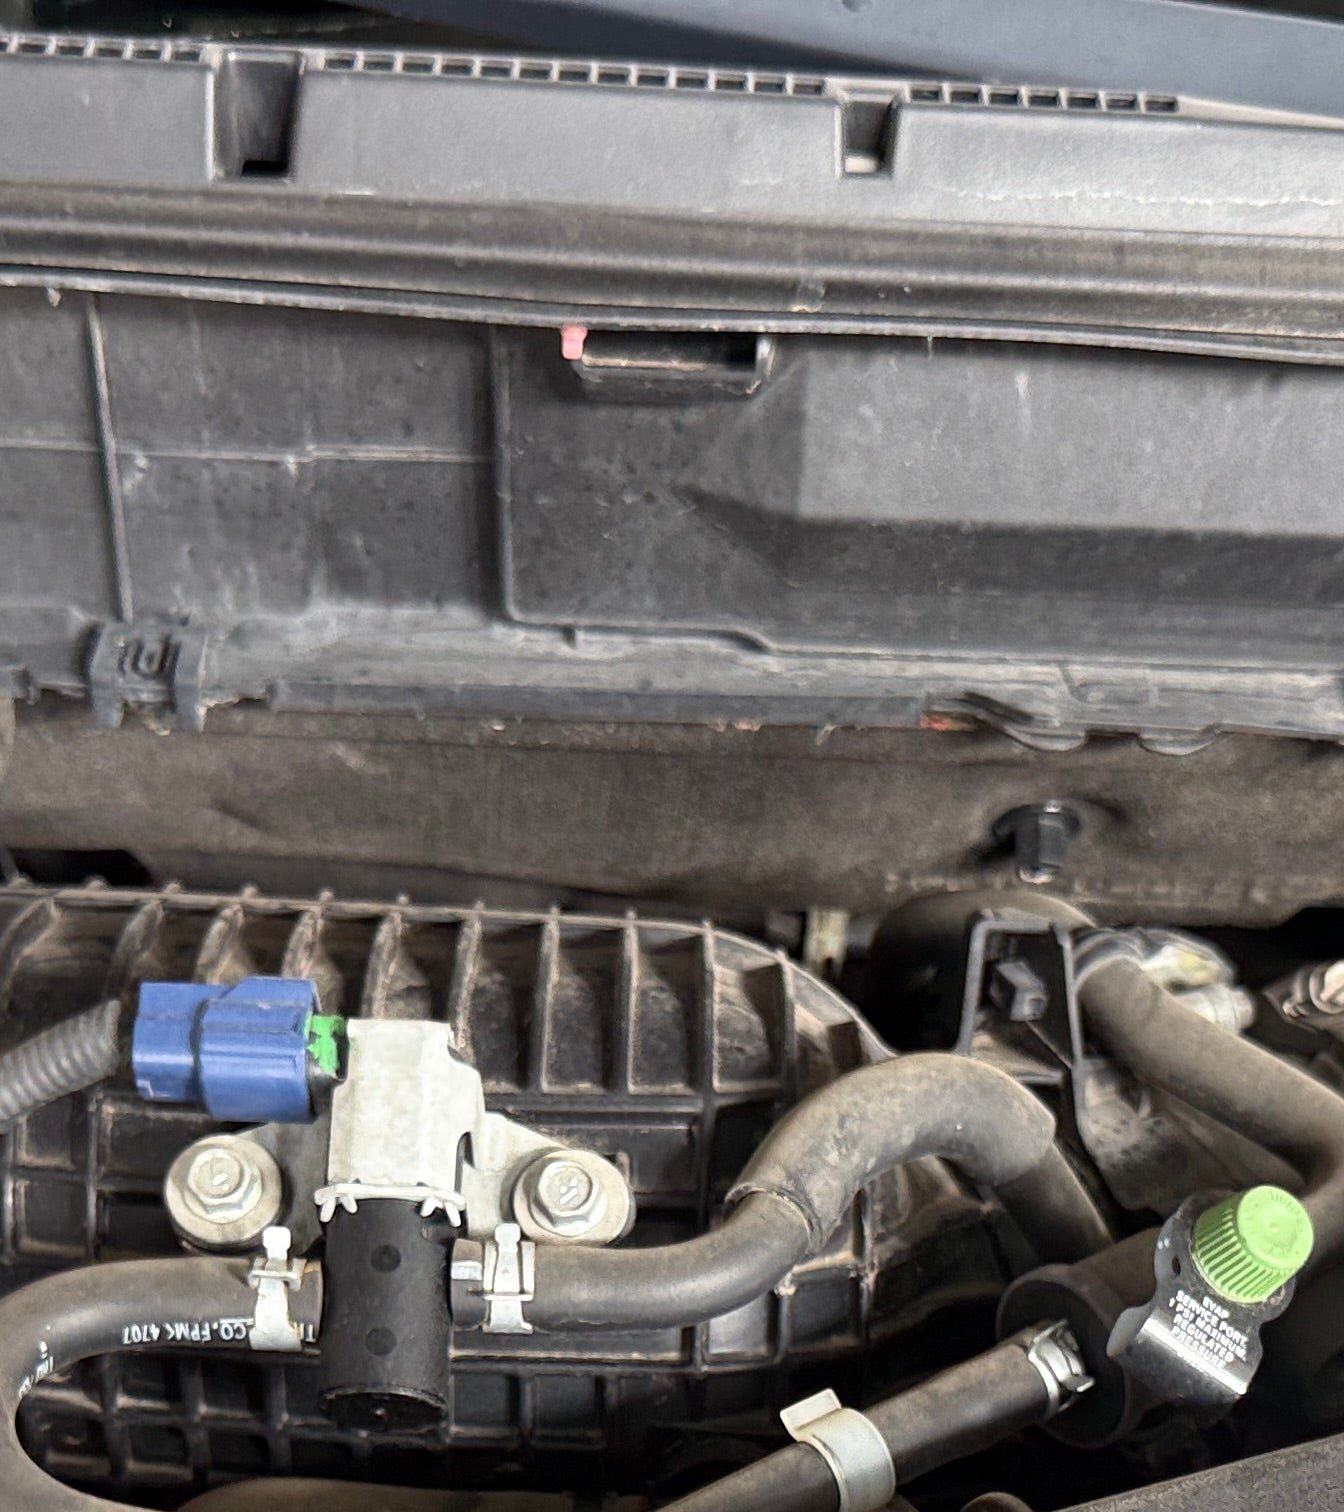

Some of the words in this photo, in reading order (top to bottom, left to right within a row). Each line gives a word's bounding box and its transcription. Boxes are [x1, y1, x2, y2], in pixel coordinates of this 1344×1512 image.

[1175, 1290, 1219, 1328] SERVICE
[1175, 1302, 1195, 1322] PSI
[122, 1322, 161, 1345] 4707
[1171, 1325, 1227, 1369] PRESSURE
[1173, 1313, 1234, 1363] REGULATED
